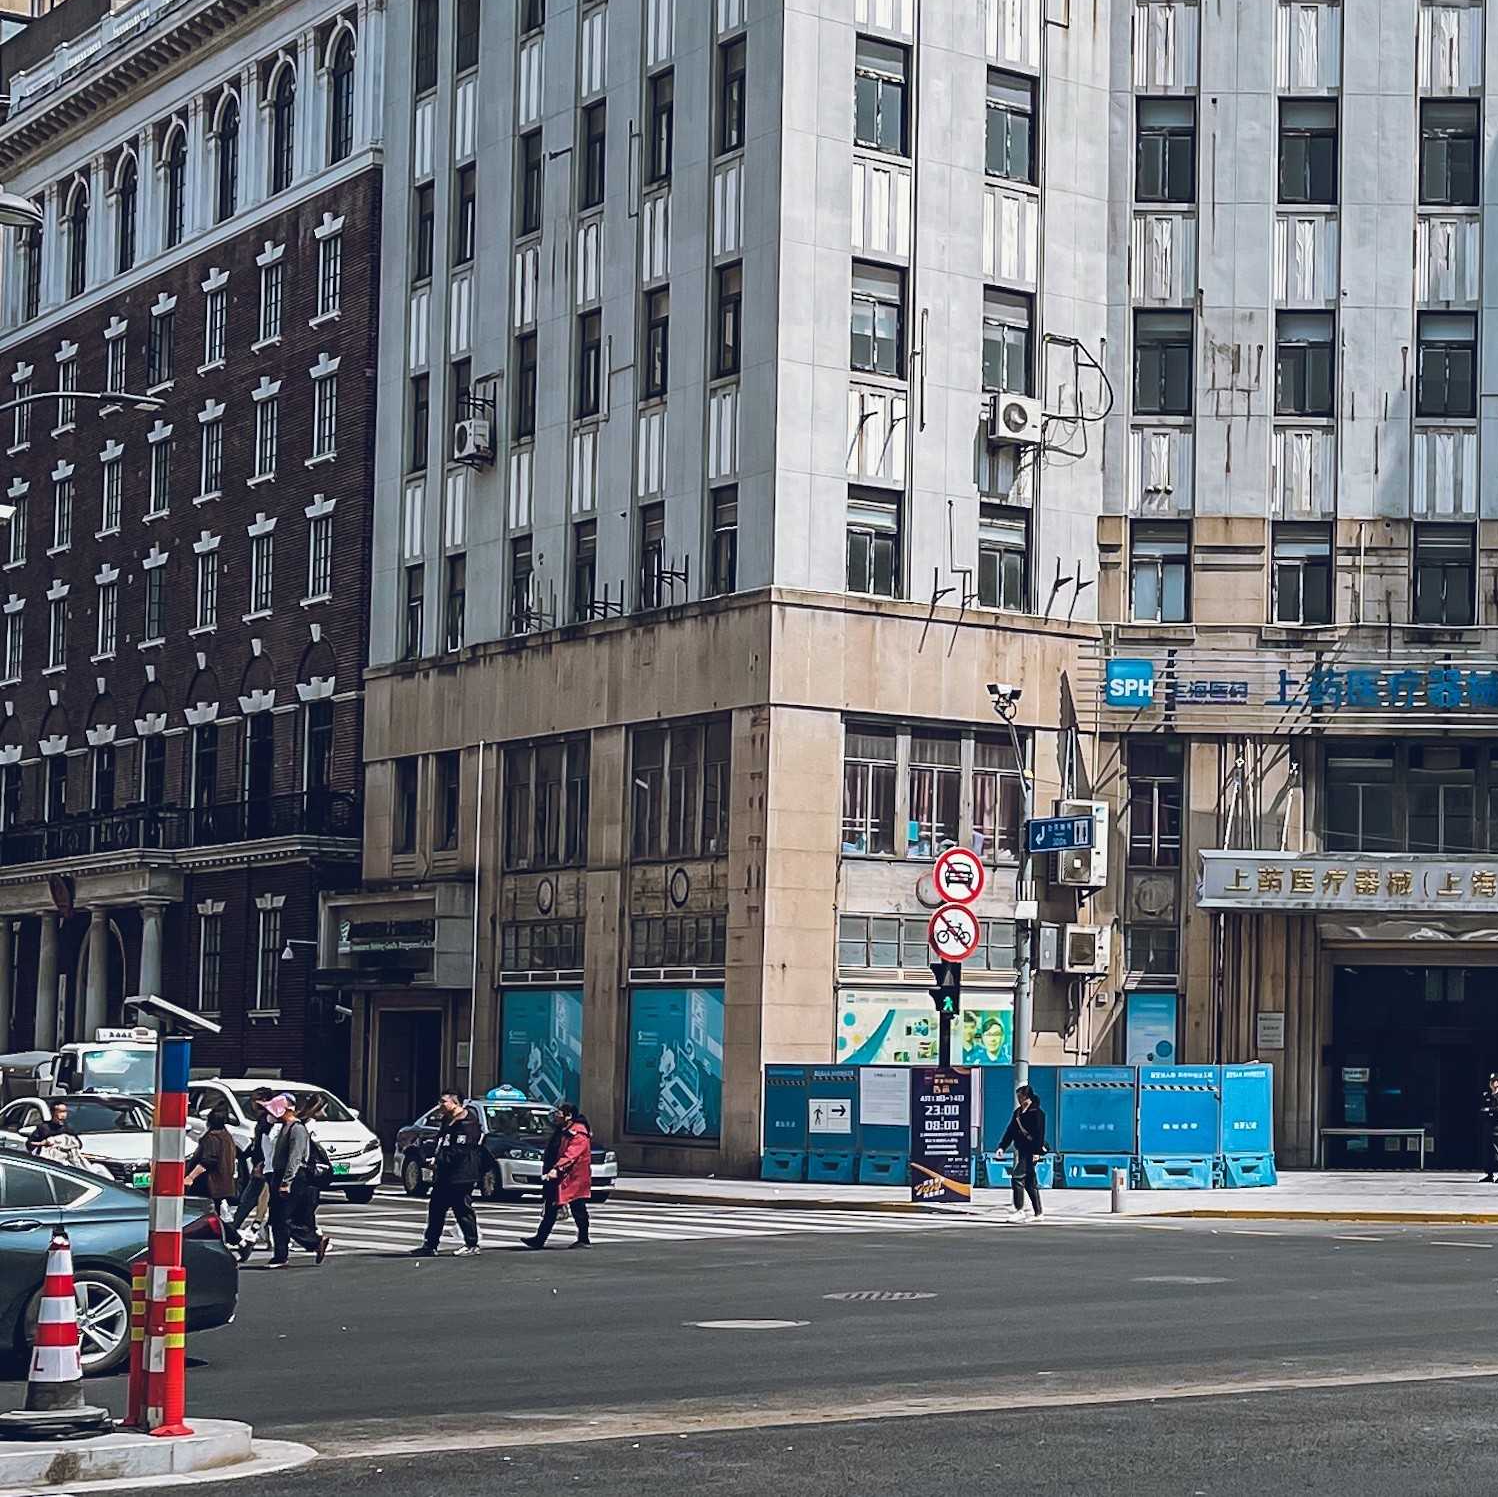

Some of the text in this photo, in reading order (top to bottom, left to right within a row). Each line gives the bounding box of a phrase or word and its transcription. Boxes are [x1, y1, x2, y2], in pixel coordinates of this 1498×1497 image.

[1109, 678, 1154, 699] SPH
[924, 1104, 960, 1116] 23:00
[924, 1120, 960, 1131] 08:00
